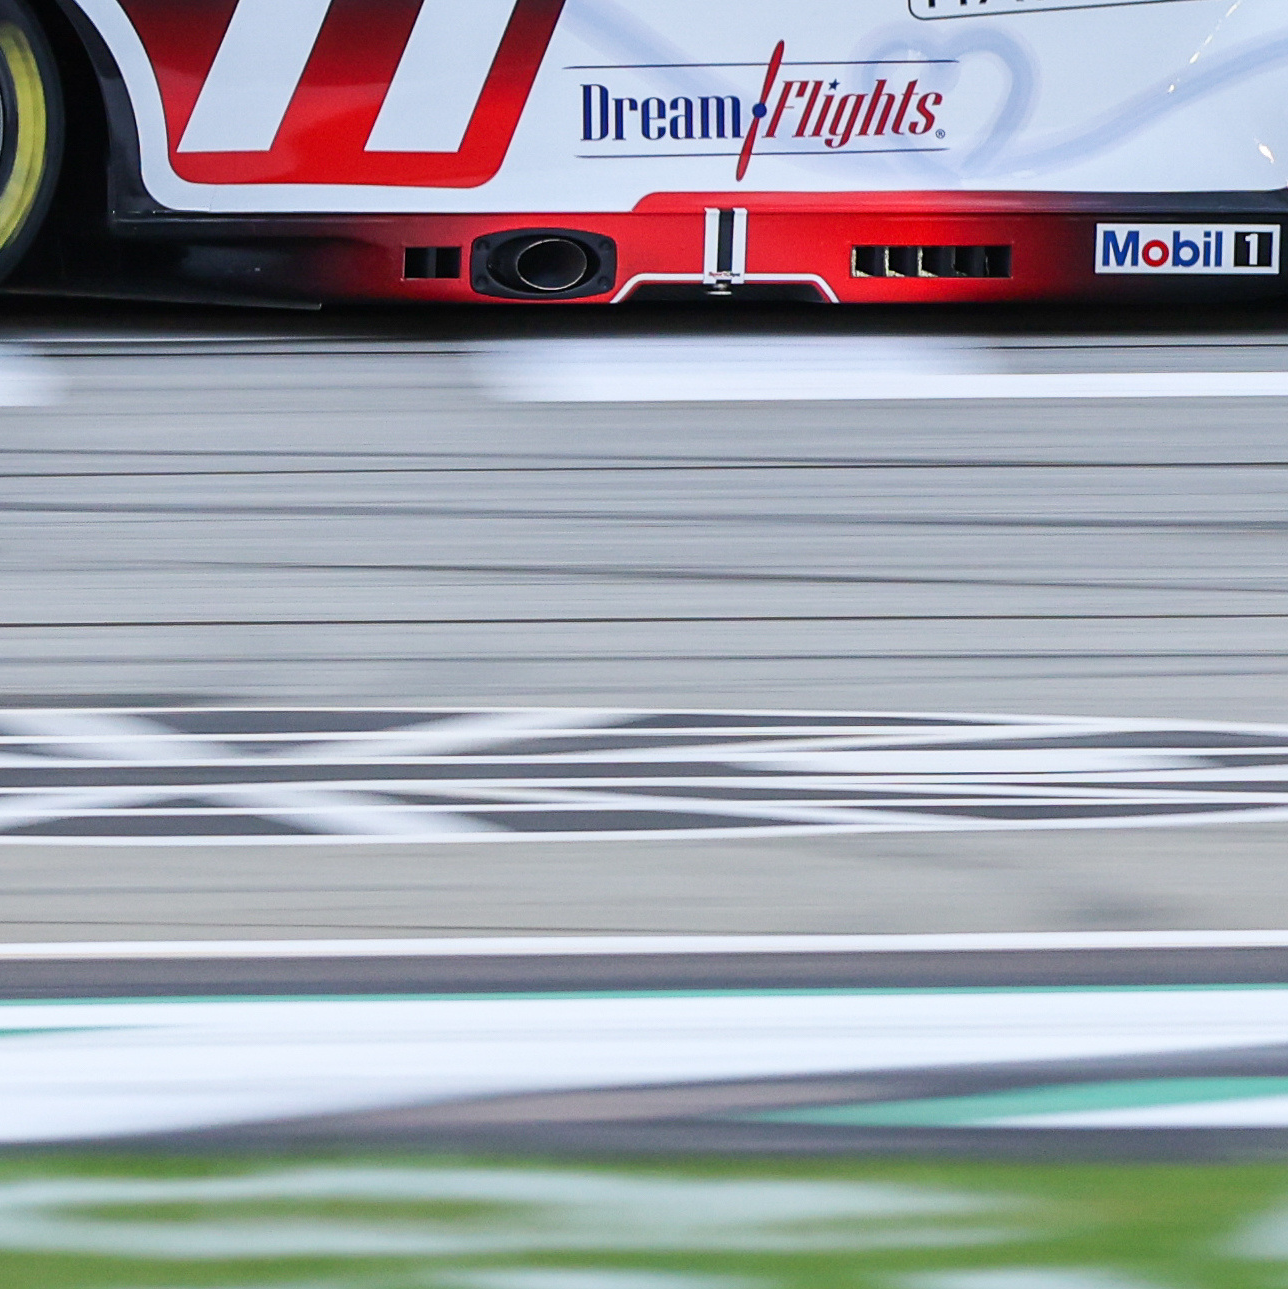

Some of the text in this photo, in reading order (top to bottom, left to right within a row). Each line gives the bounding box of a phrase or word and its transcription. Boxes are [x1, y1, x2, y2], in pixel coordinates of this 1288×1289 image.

[580, 78, 944, 149] Dream Flights
[1102, 230, 1223, 268] Mobil
